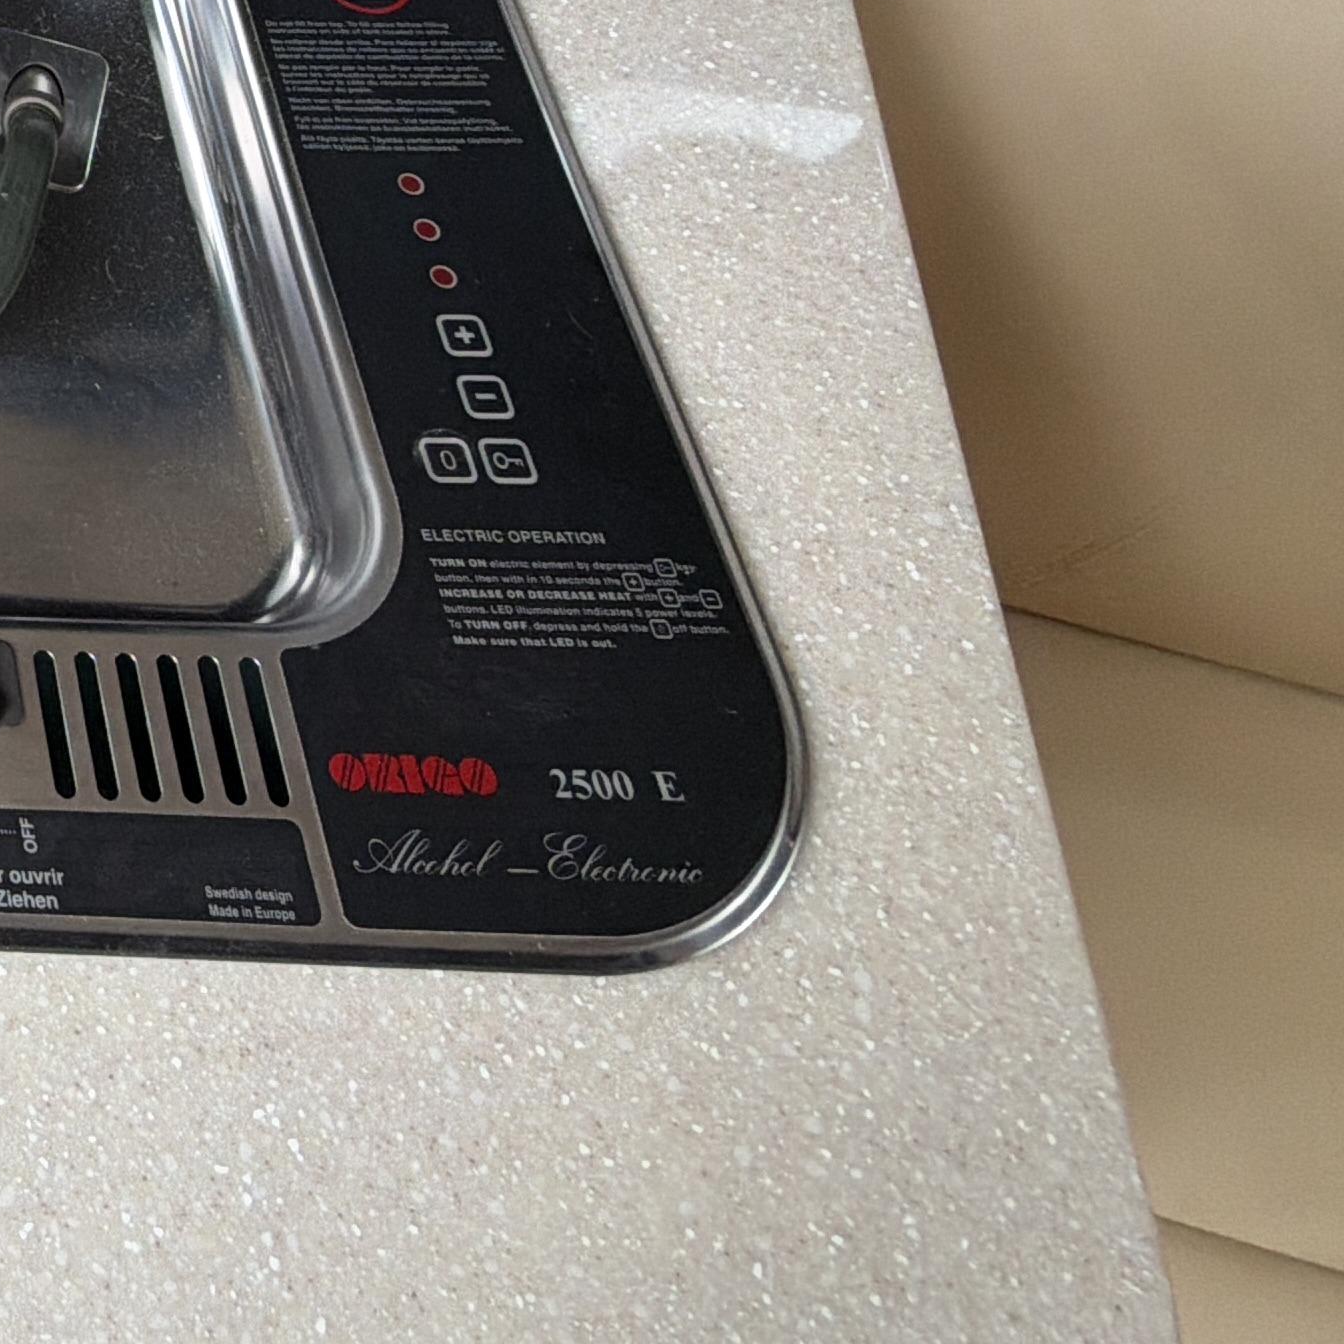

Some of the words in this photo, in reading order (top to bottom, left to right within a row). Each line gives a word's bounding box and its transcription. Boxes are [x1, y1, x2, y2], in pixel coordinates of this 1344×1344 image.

[420, 528, 503, 543] ELECTRIC
[507, 530, 605, 544] OPERATION
[429, 557, 466, 567] TURN
[467, 558, 488, 568] ON
[438, 588, 503, 599] INCREASE
[506, 589, 525, 599] OR
[527, 589, 595, 600] DECREASE
[598, 591, 631, 601] HEAT
[452, 634, 487, 645] Make
[519, 637, 547, 647] that
[548, 636, 574, 647] LED
[549, 768, 634, 801] 2500
[651, 770, 686, 803] E
[19, 817, 38, 854] OFF
[353, 829, 504, 874] Alcohol
[543, 832, 703, 883] Electronic
[8, 868, 63, 885] ouvrir
[205, 885, 252, 899] Swedish
[255, 888, 293, 905] design
[208, 904, 239, 917] Made
[241, 905, 252, 918] in
[254, 906, 295, 921] Europe
